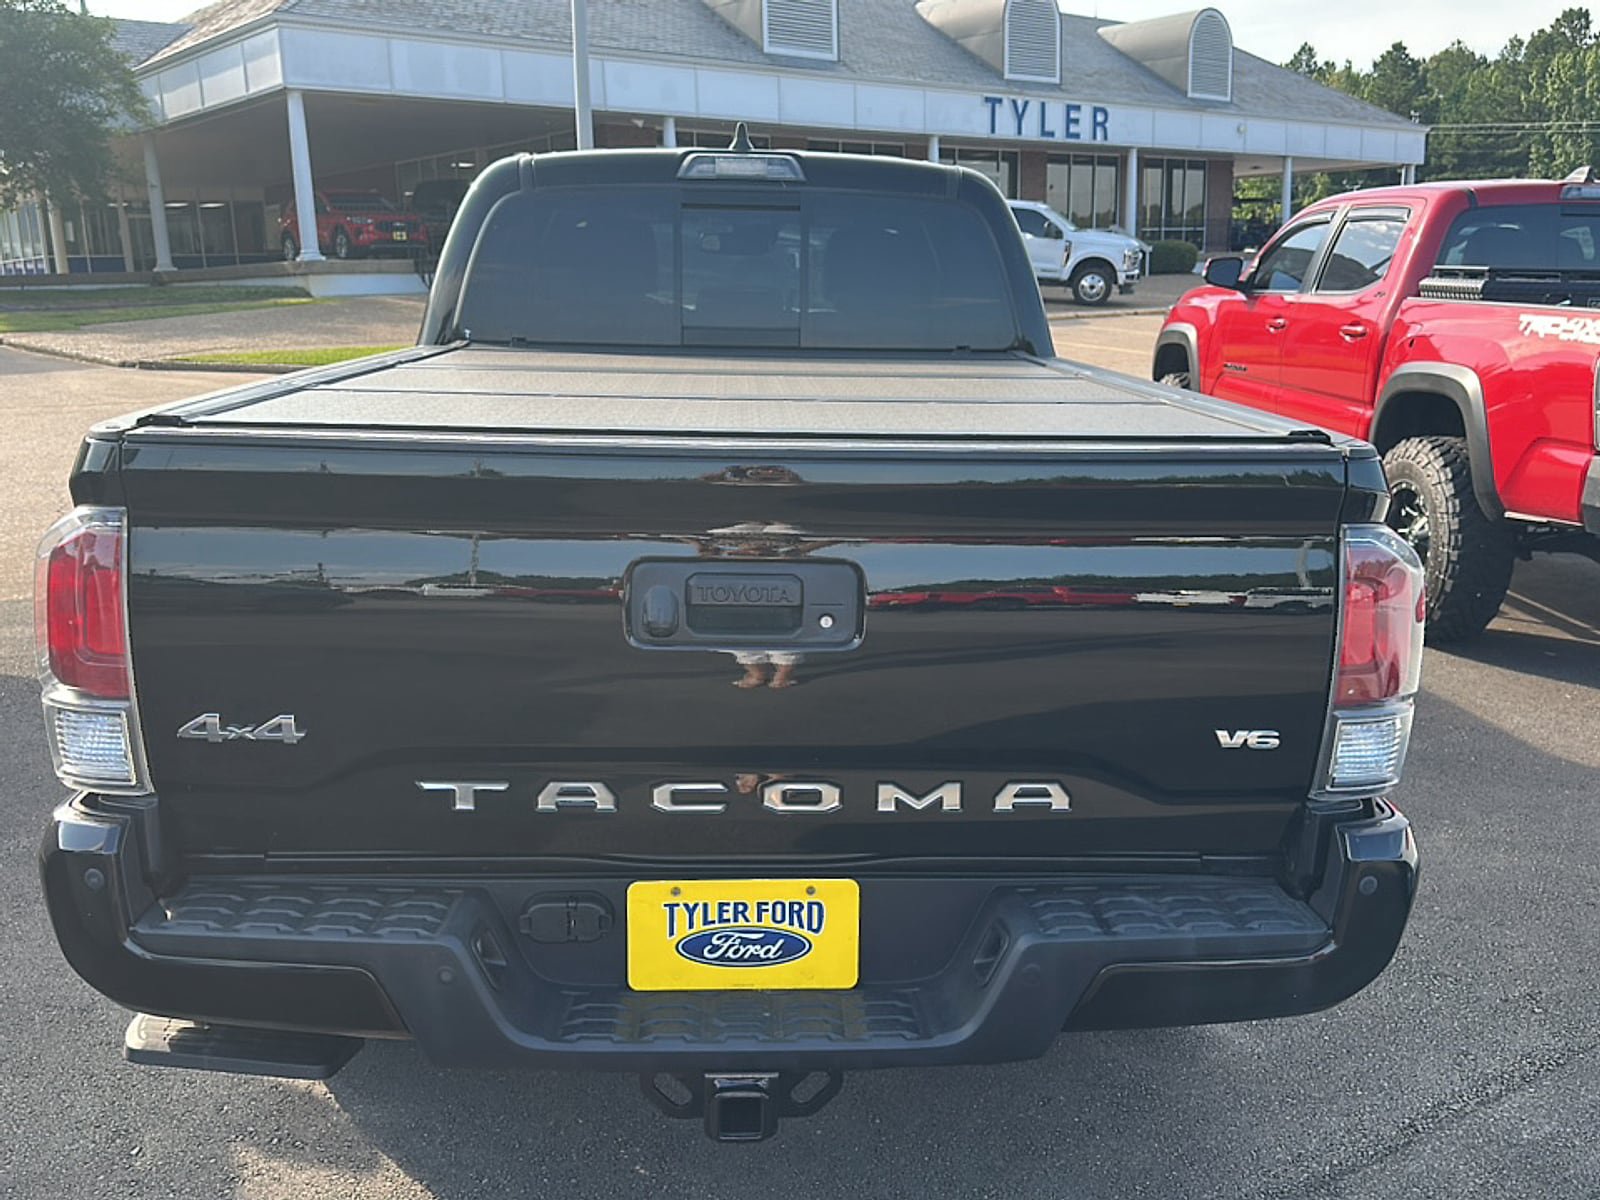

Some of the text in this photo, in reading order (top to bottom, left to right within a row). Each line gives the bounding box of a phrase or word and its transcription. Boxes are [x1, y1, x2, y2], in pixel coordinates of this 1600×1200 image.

[984, 96, 1109, 141] TYLER
[697, 585, 791, 603] TOYOTA
[1215, 729, 1281, 750] V6
[415, 780, 1073, 813] TACOMA
[663, 900, 825, 938] TYLER FORD
[702, 931, 785, 960] Ford
